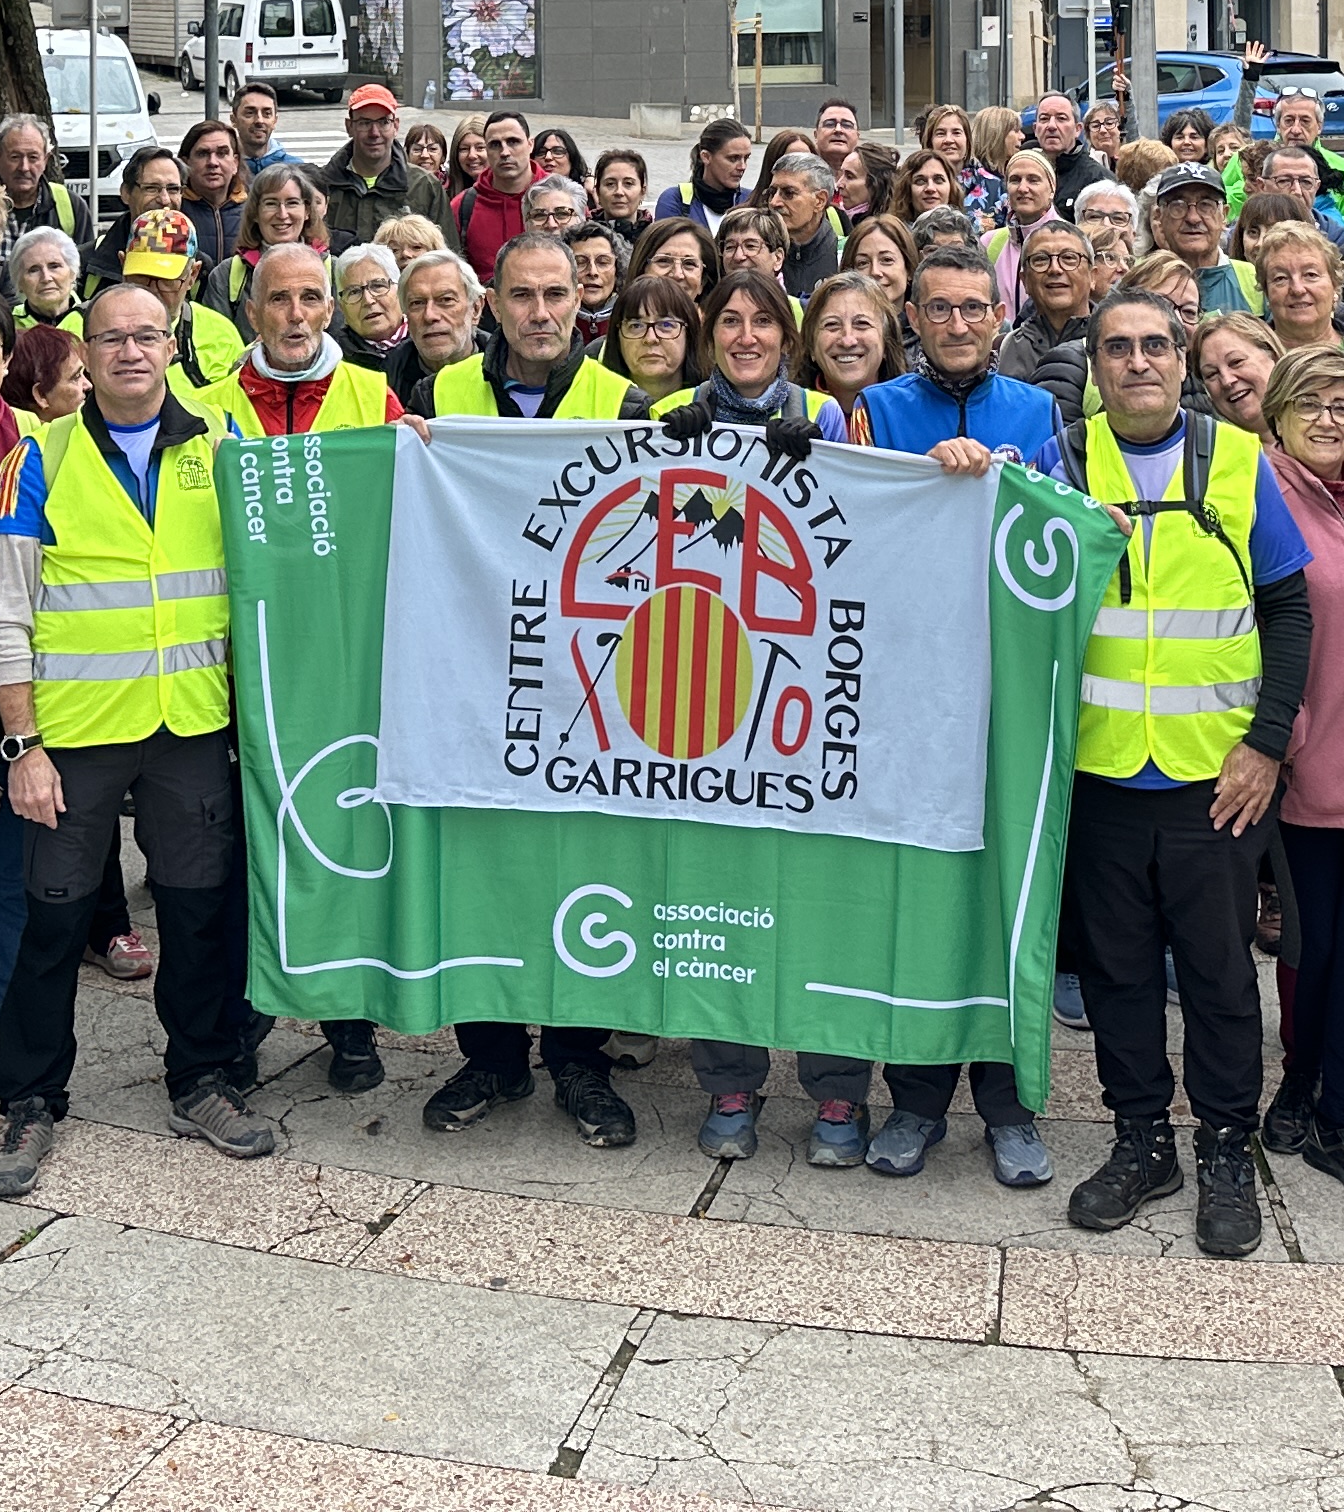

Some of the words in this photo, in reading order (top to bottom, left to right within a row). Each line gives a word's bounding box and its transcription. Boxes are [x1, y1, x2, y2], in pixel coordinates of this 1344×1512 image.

[1177, 161, 1209, 179] NY
[239, 452, 268, 544] càncer
[271, 436, 295, 505] ontra
[303, 434, 336, 557] ssociació
[522, 426, 853, 569] EXCURSIONISTA
[561, 468, 816, 636] CEB
[503, 578, 548, 777] CENTRE
[820, 598, 866, 801] BORGES
[545, 755, 815, 814] GARRIGUES
[653, 901, 775, 929] associació
[653, 929, 726, 952] contra
[652, 957, 670, 979] el
[675, 956, 757, 985] càncer
